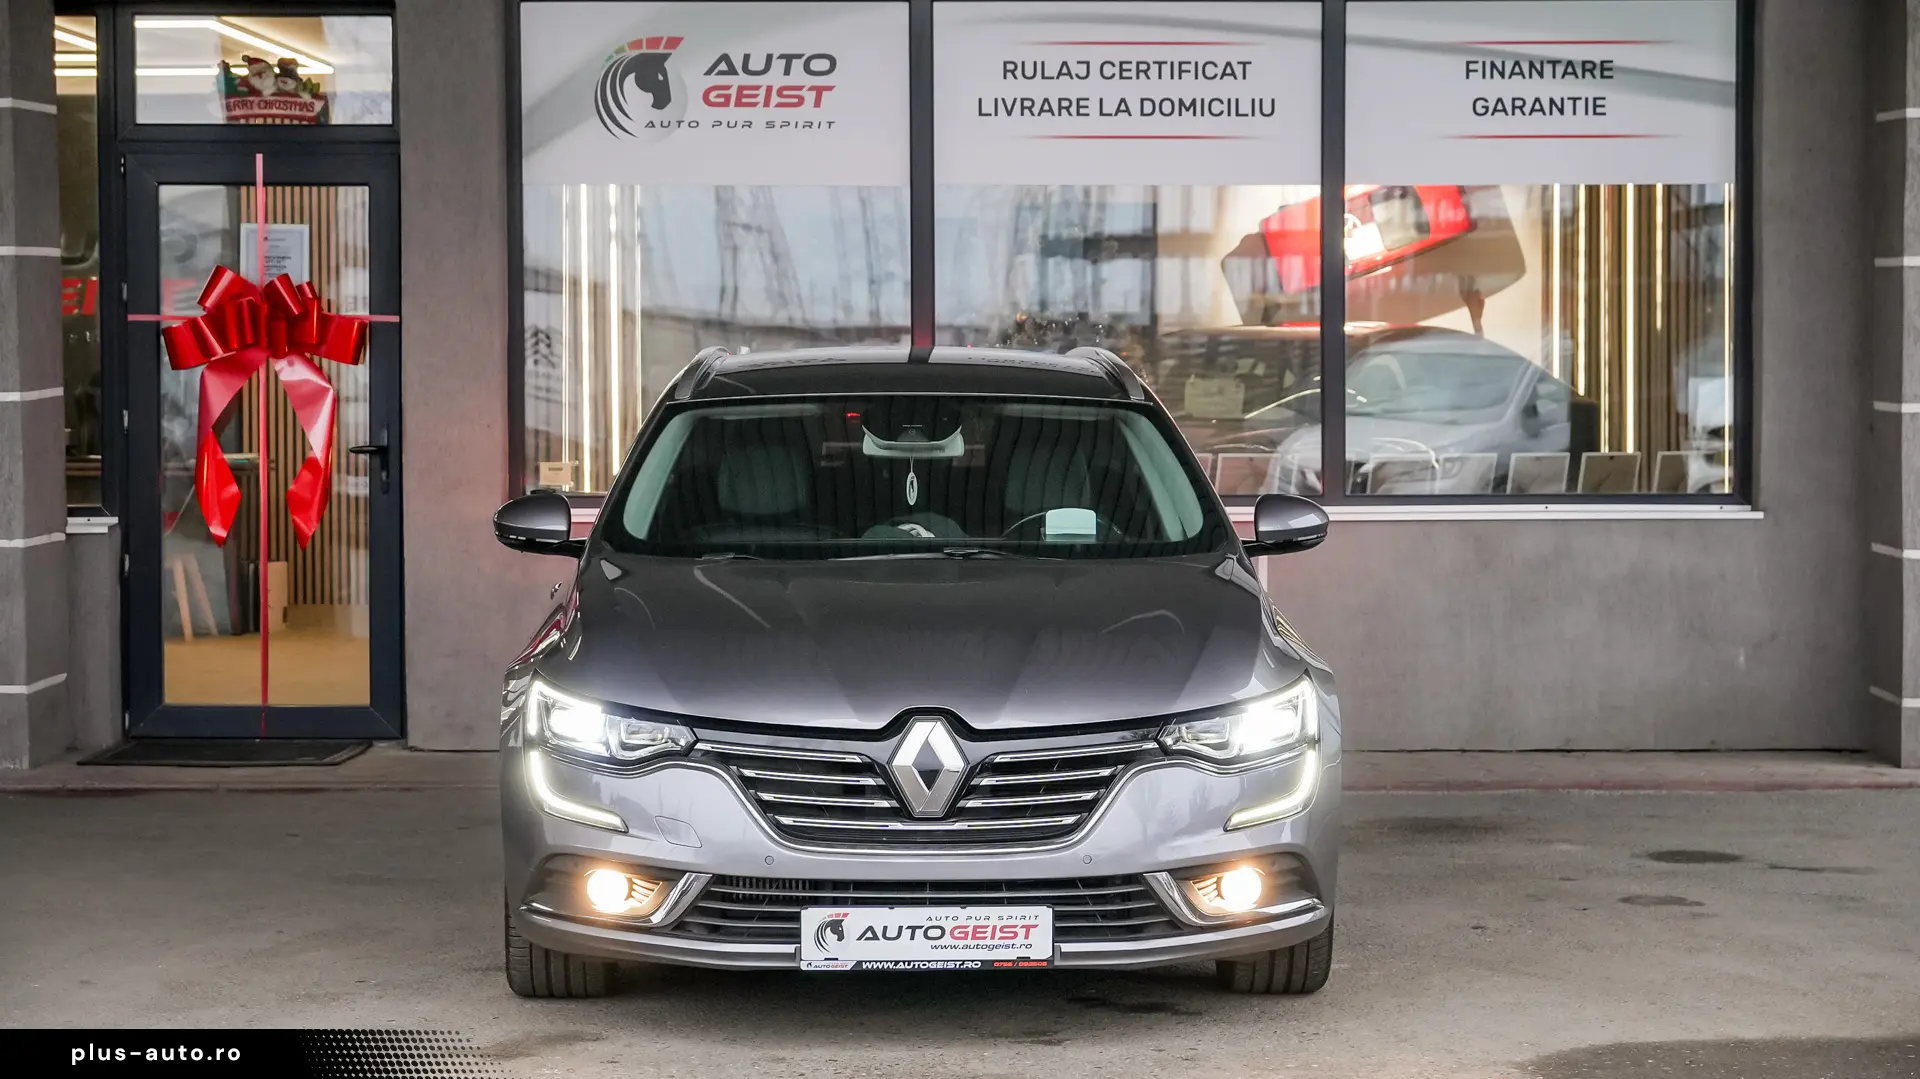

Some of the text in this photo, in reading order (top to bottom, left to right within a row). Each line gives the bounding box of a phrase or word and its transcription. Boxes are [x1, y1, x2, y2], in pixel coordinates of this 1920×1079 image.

[703, 53, 838, 77] AUTO
[1002, 60, 1253, 81] RULAJ CERTIFICAT
[1465, 60, 1615, 80] FINANTARE
[226, 99, 315, 113] ERRY CHRISTMAS
[702, 84, 837, 109] GEIST
[977, 97, 1277, 118] LIVRARE LA DOMICILIU
[1472, 97, 1607, 117] GARANTIE
[644, 119, 836, 130] AUTO PUR SPIRIT
[855, 924, 1040, 942] AUTOGEIST
[930, 942, 1033, 952] www.autogeist.ro
[862, 961, 982, 969] WWW.AUTOGEIST.RO
